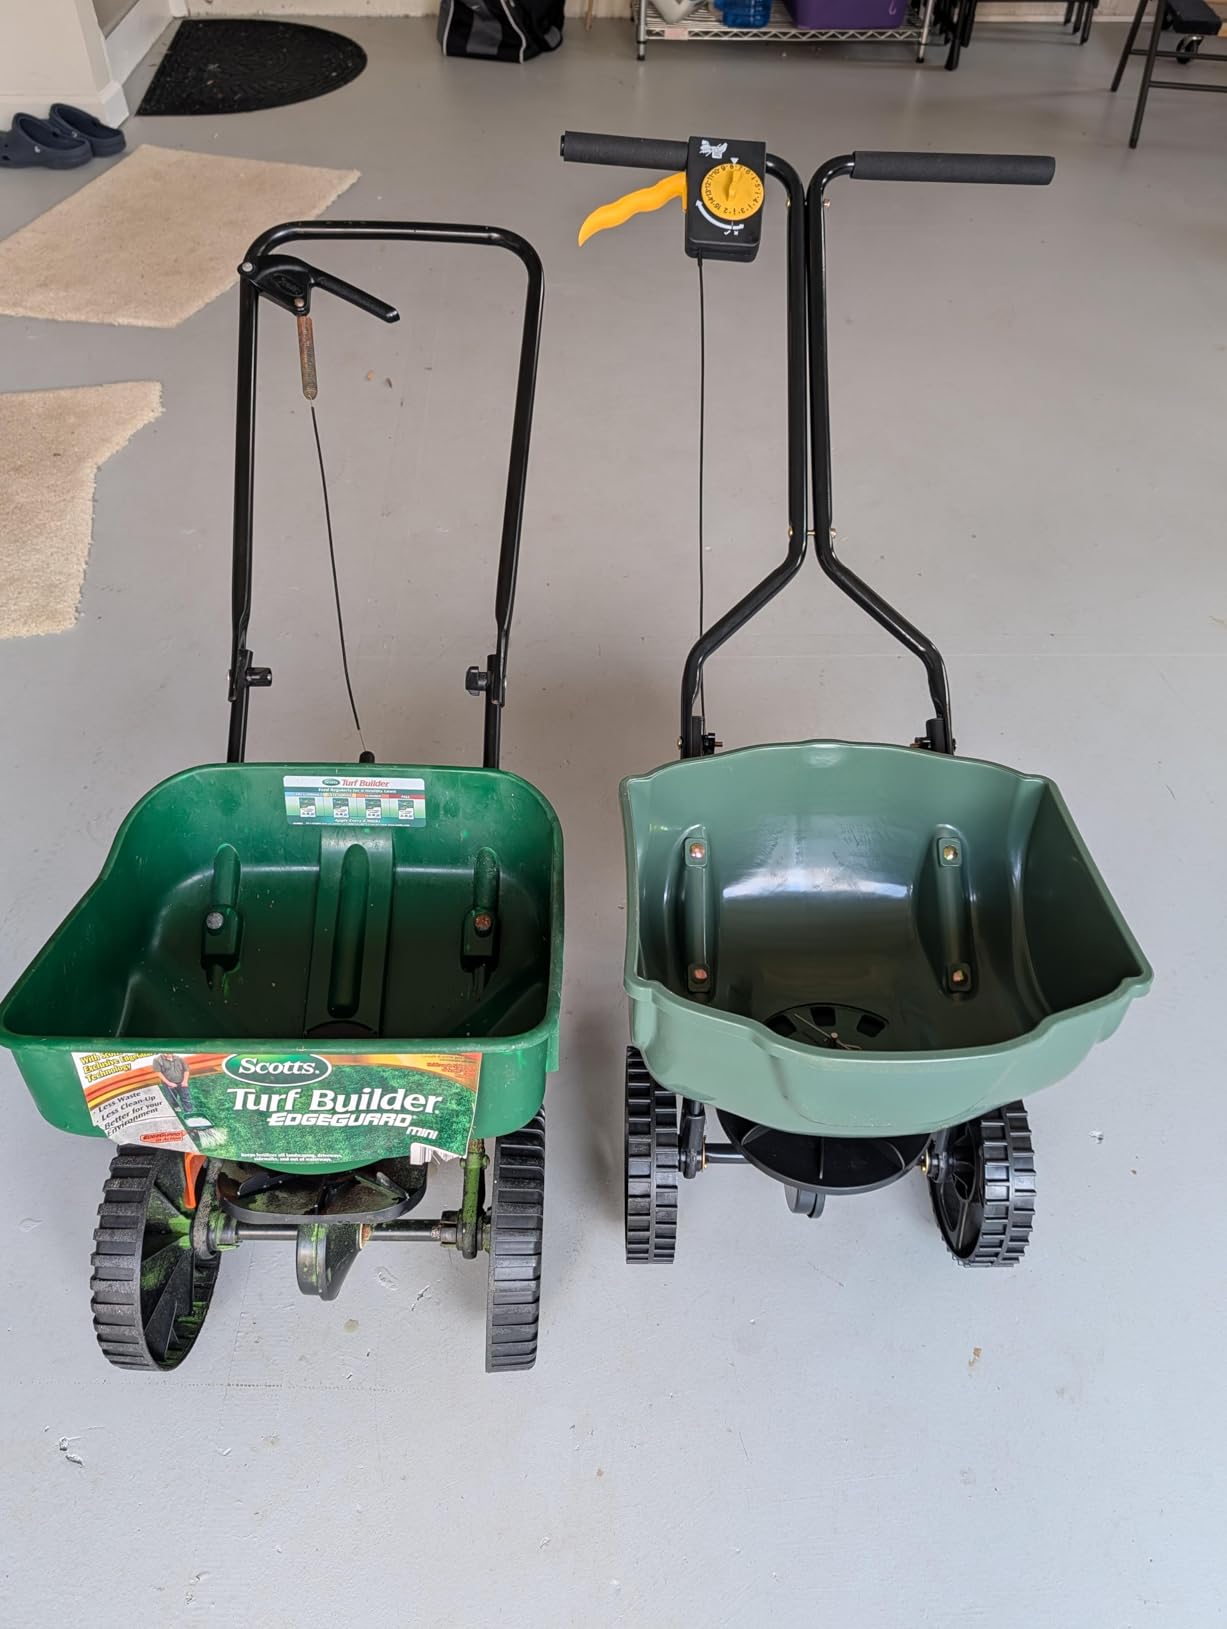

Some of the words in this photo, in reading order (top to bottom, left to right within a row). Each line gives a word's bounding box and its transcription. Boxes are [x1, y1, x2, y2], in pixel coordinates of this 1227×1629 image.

[341, 779, 359, 787] Turf
[359, 779, 390, 788] Builder
[83, 1059, 120, 1074] Exclusive
[85, 1063, 132, 1082] Technology
[98, 1101, 116, 1113] Less
[117, 1092, 142, 1103] Waste
[101, 1109, 119, 1121] Less
[120, 1095, 156, 1110] Clean-Up
[227, 1088, 302, 1112] Turf
[309, 1087, 444, 1114] Builder
[104, 1112, 130, 1131] Better
[131, 1106, 145, 1115] for
[145, 1101, 163, 1110] your
[106, 1107, 159, 1137] Environment
[266, 1112, 412, 1128] EDGEGUARD
[406, 1126, 439, 1140] mini
